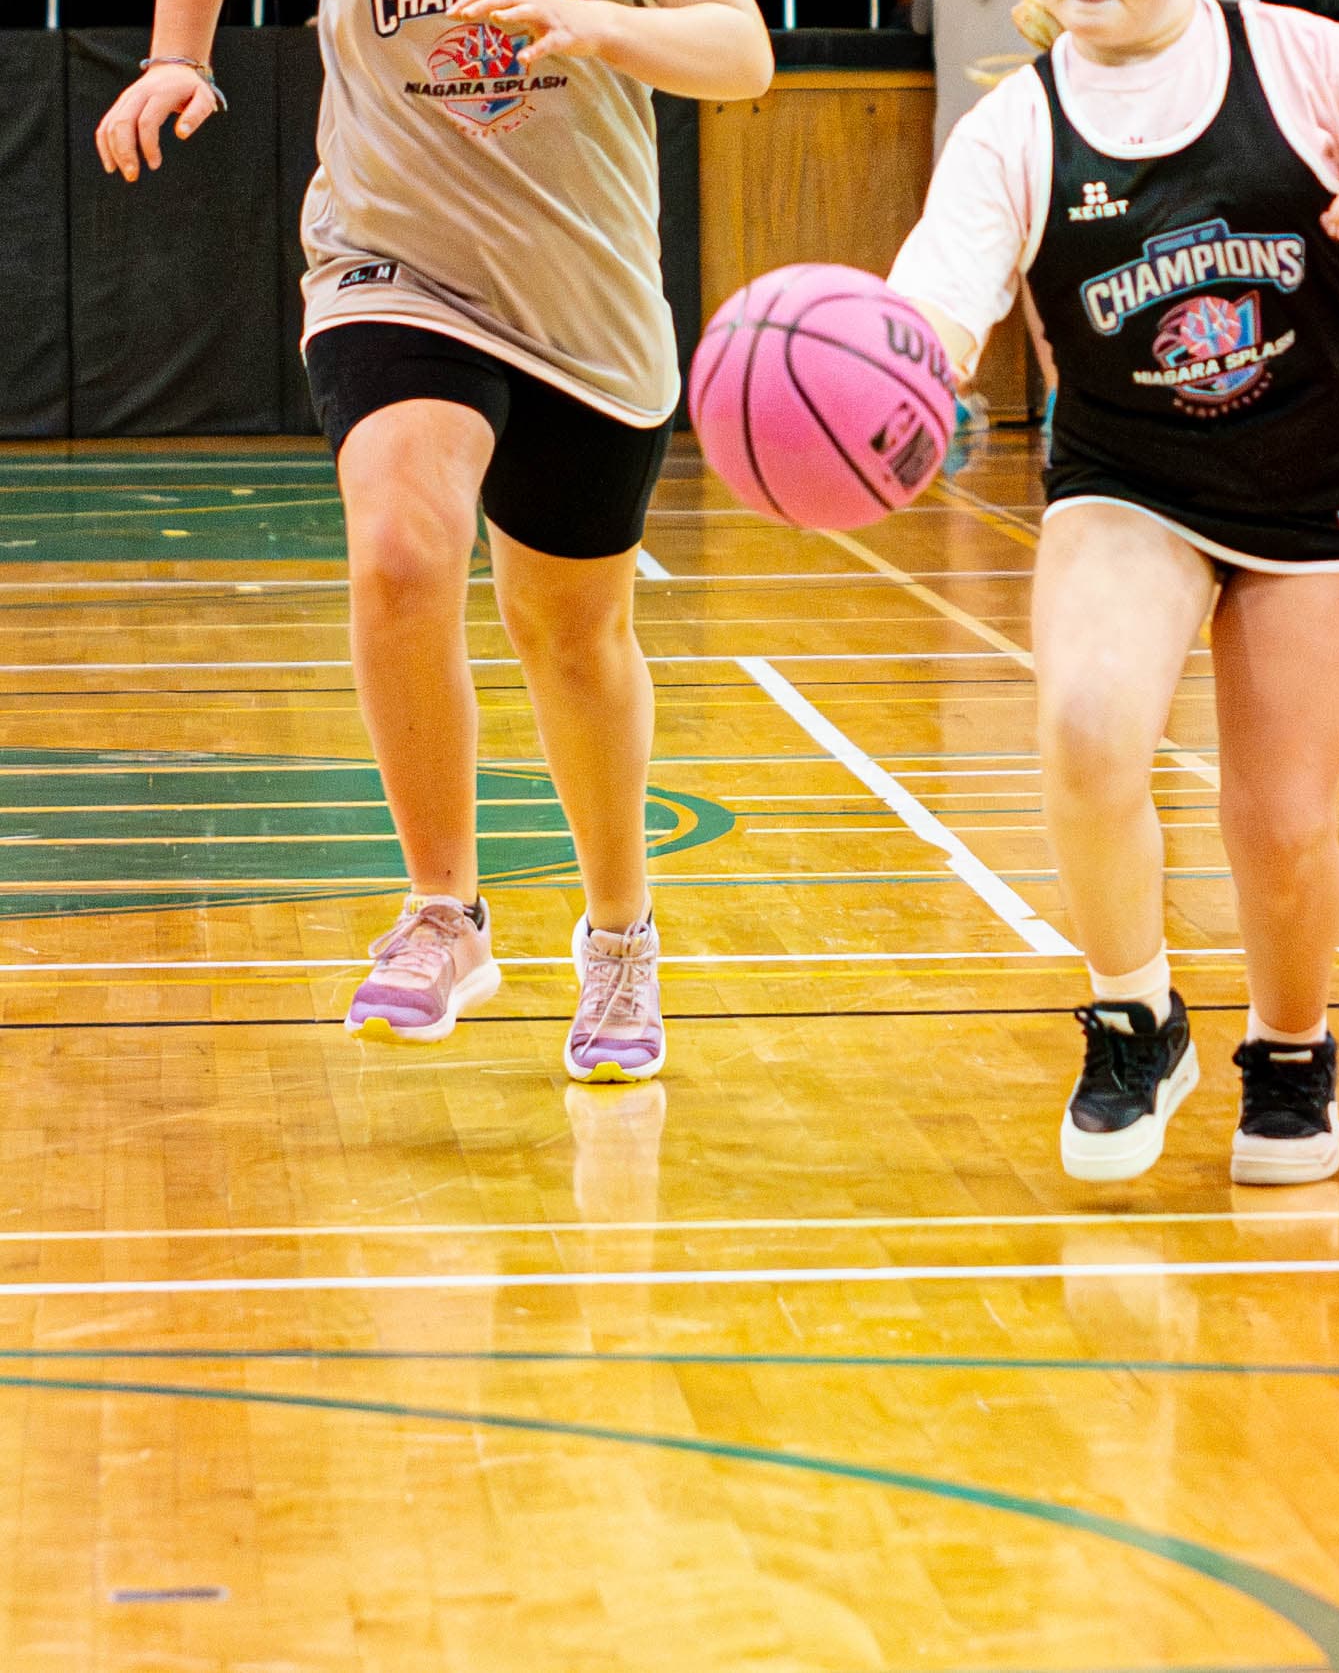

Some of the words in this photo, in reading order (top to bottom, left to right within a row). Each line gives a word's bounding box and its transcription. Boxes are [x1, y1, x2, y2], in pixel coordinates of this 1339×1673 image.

[404, 81, 485, 97] NIAGARA
[493, 76, 569, 93] SPLASH
[1086, 238, 1304, 331] CHAMPIONS
[1132, 359, 1221, 386] NIAGARA
